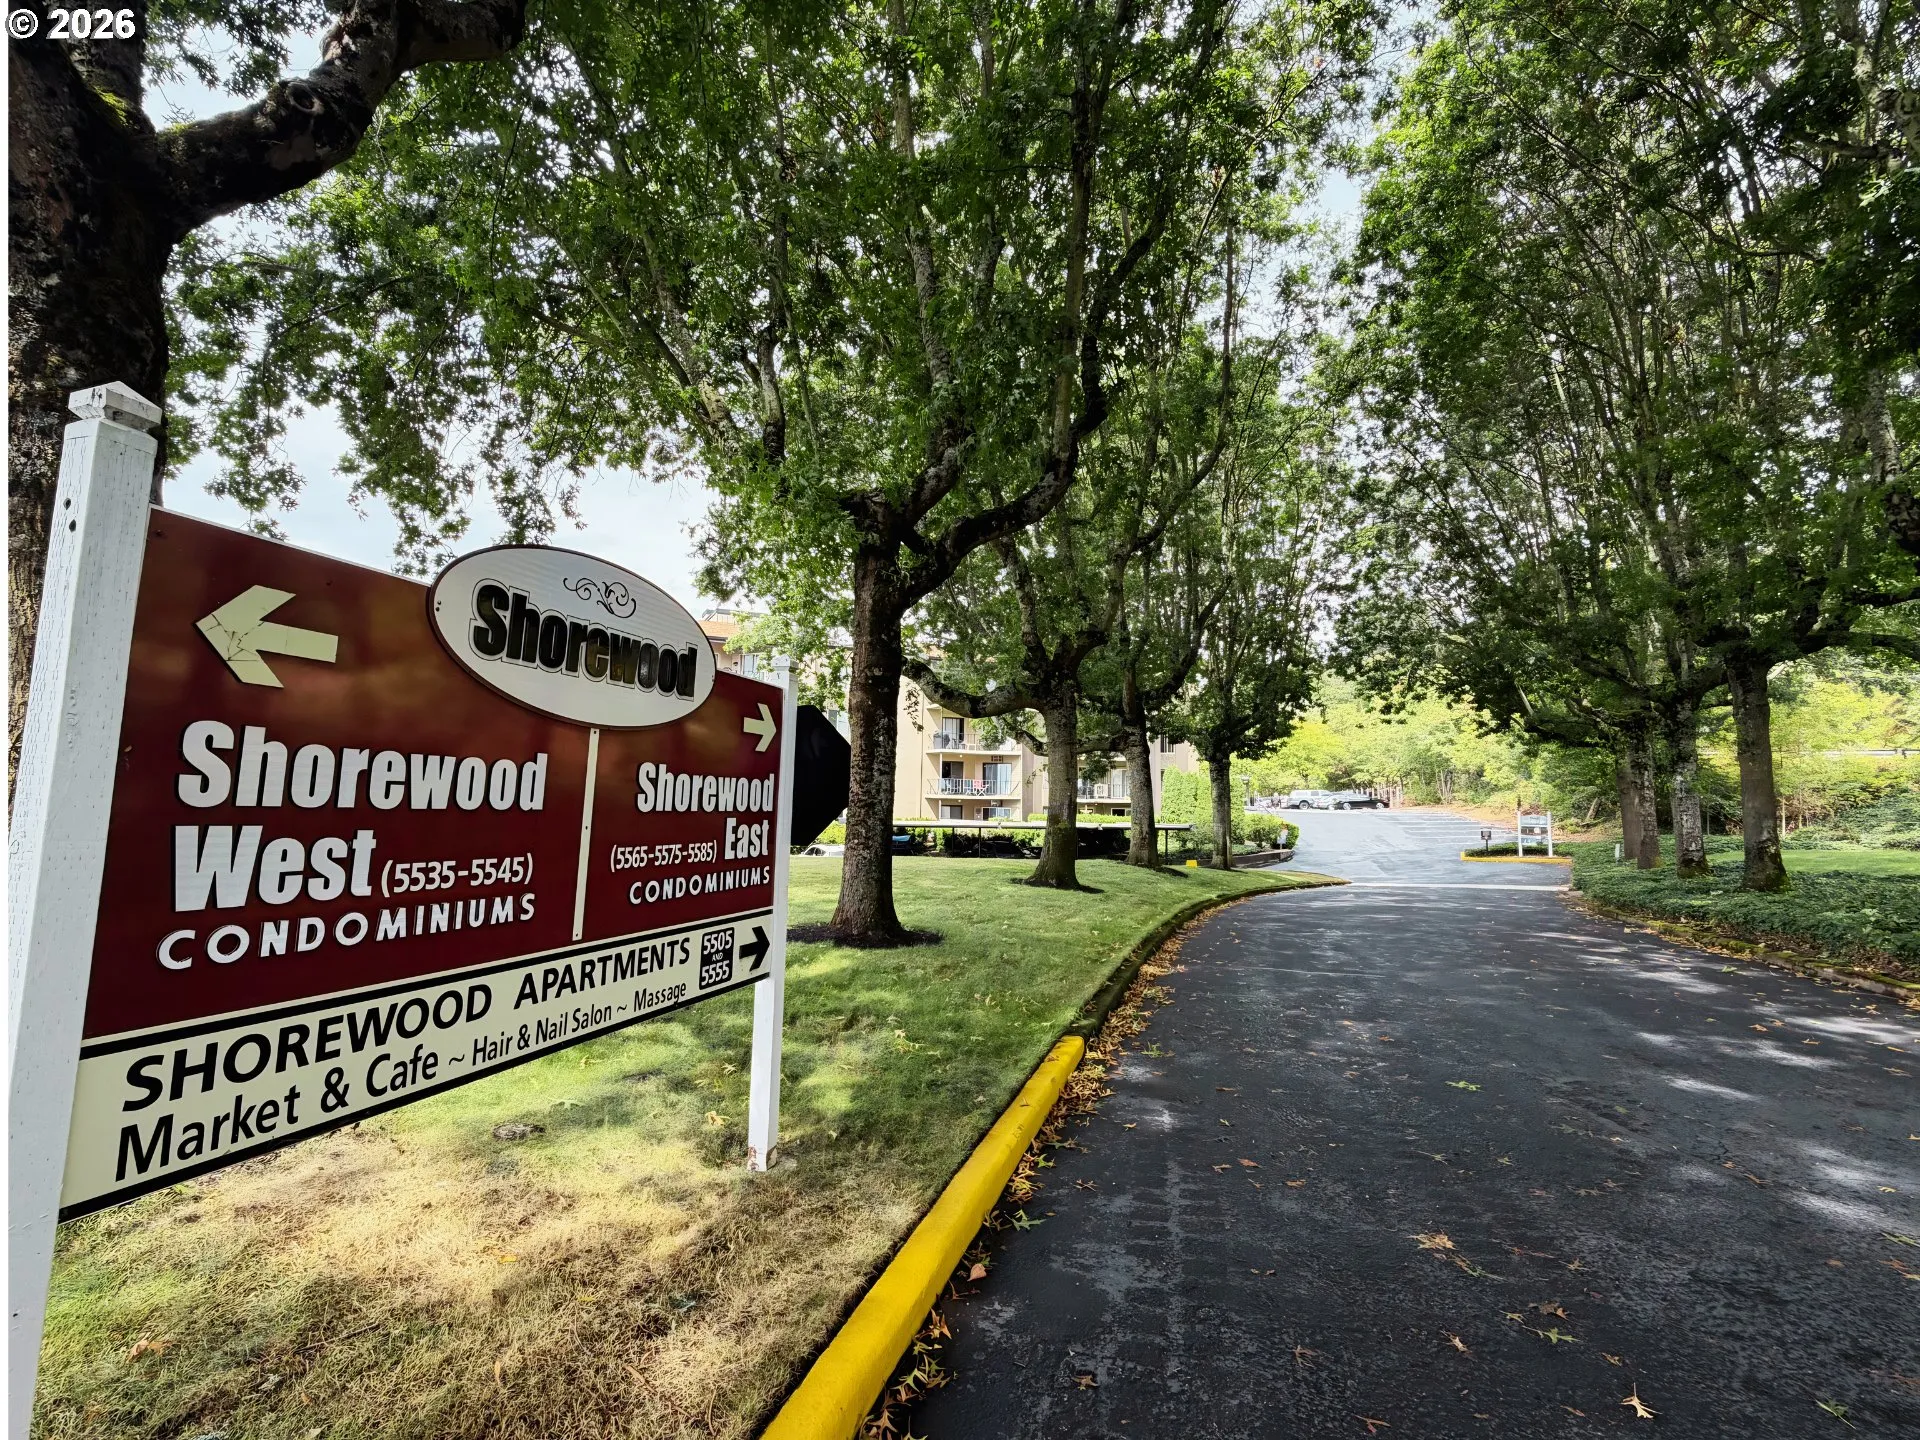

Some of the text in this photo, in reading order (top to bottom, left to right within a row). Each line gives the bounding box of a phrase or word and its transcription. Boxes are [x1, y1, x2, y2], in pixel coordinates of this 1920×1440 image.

[470, 579, 698, 702] Shorewood
[177, 719, 548, 811] Shorewood
[637, 762, 775, 812] Shorewood
[174, 824, 534, 913] West (5535-5545)
[610, 817, 769, 873] (5565-5575-5585) East
[629, 866, 770, 905] CONDOMINIUMS
[156, 893, 536, 970] CONDOMINIUMS
[703, 930, 733, 955] 5505
[711, 952, 724, 962] AND
[701, 960, 730, 986] 5555
[121, 937, 691, 1112] SHOREWOOD APARTMENTS
[115, 1084, 300, 1183] Market
[320, 1066, 350, 1113] &
[366, 1043, 439, 1098] Cafe
[472, 1031, 514, 1066] Hair
[517, 1023, 531, 1051] &
[535, 1011, 569, 1046] Nail
[571, 1003, 612, 1033] Salon
[633, 982, 687, 1012] Massage
